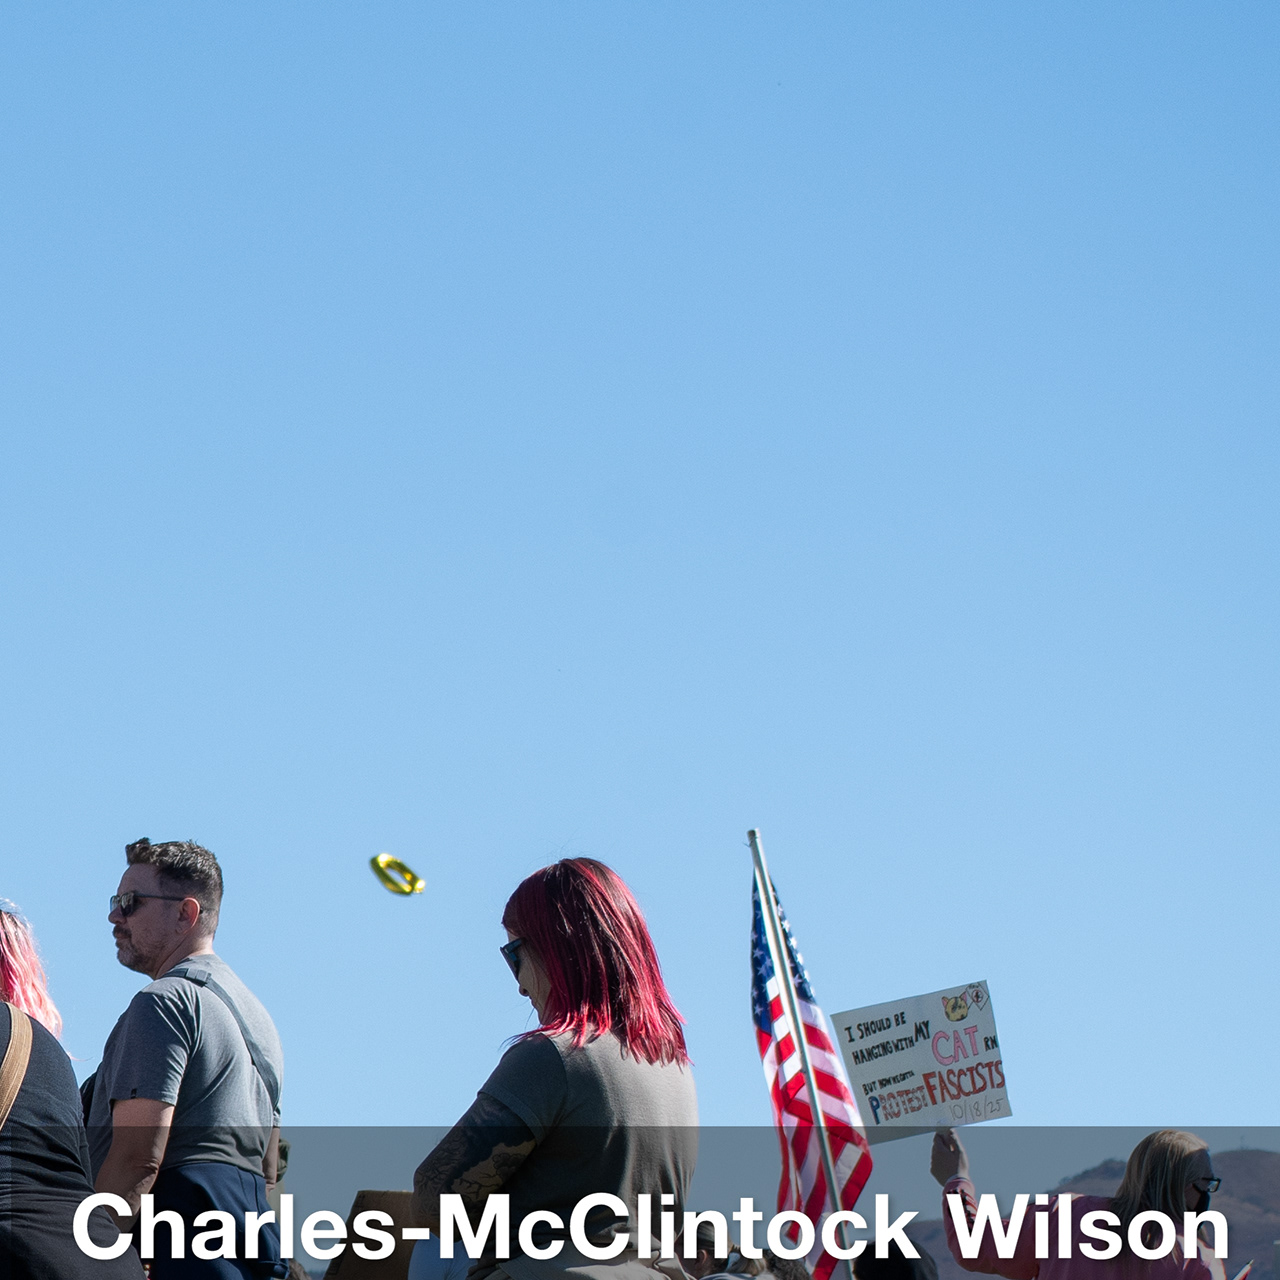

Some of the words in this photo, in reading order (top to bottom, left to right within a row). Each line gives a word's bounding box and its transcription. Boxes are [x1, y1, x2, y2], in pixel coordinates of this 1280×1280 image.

[845, 1026, 856, 1043] I
[857, 1018, 892, 1040] SHOULD
[893, 1011, 907, 1028] BE
[852, 1043, 894, 1066] HANGING
[891, 1036, 916, 1053] WITH
[913, 1020, 931, 1043] MY
[931, 1024, 980, 1067] CAT
[983, 1035, 998, 1052] RN
[862, 1083, 877, 1096] BUT
[877, 1076, 893, 1090] NOW
[868, 1085, 929, 1125] PROTEST
[922, 1060, 1006, 1105] FASCISTS
[949, 1095, 1006, 1121] 10/18/25
